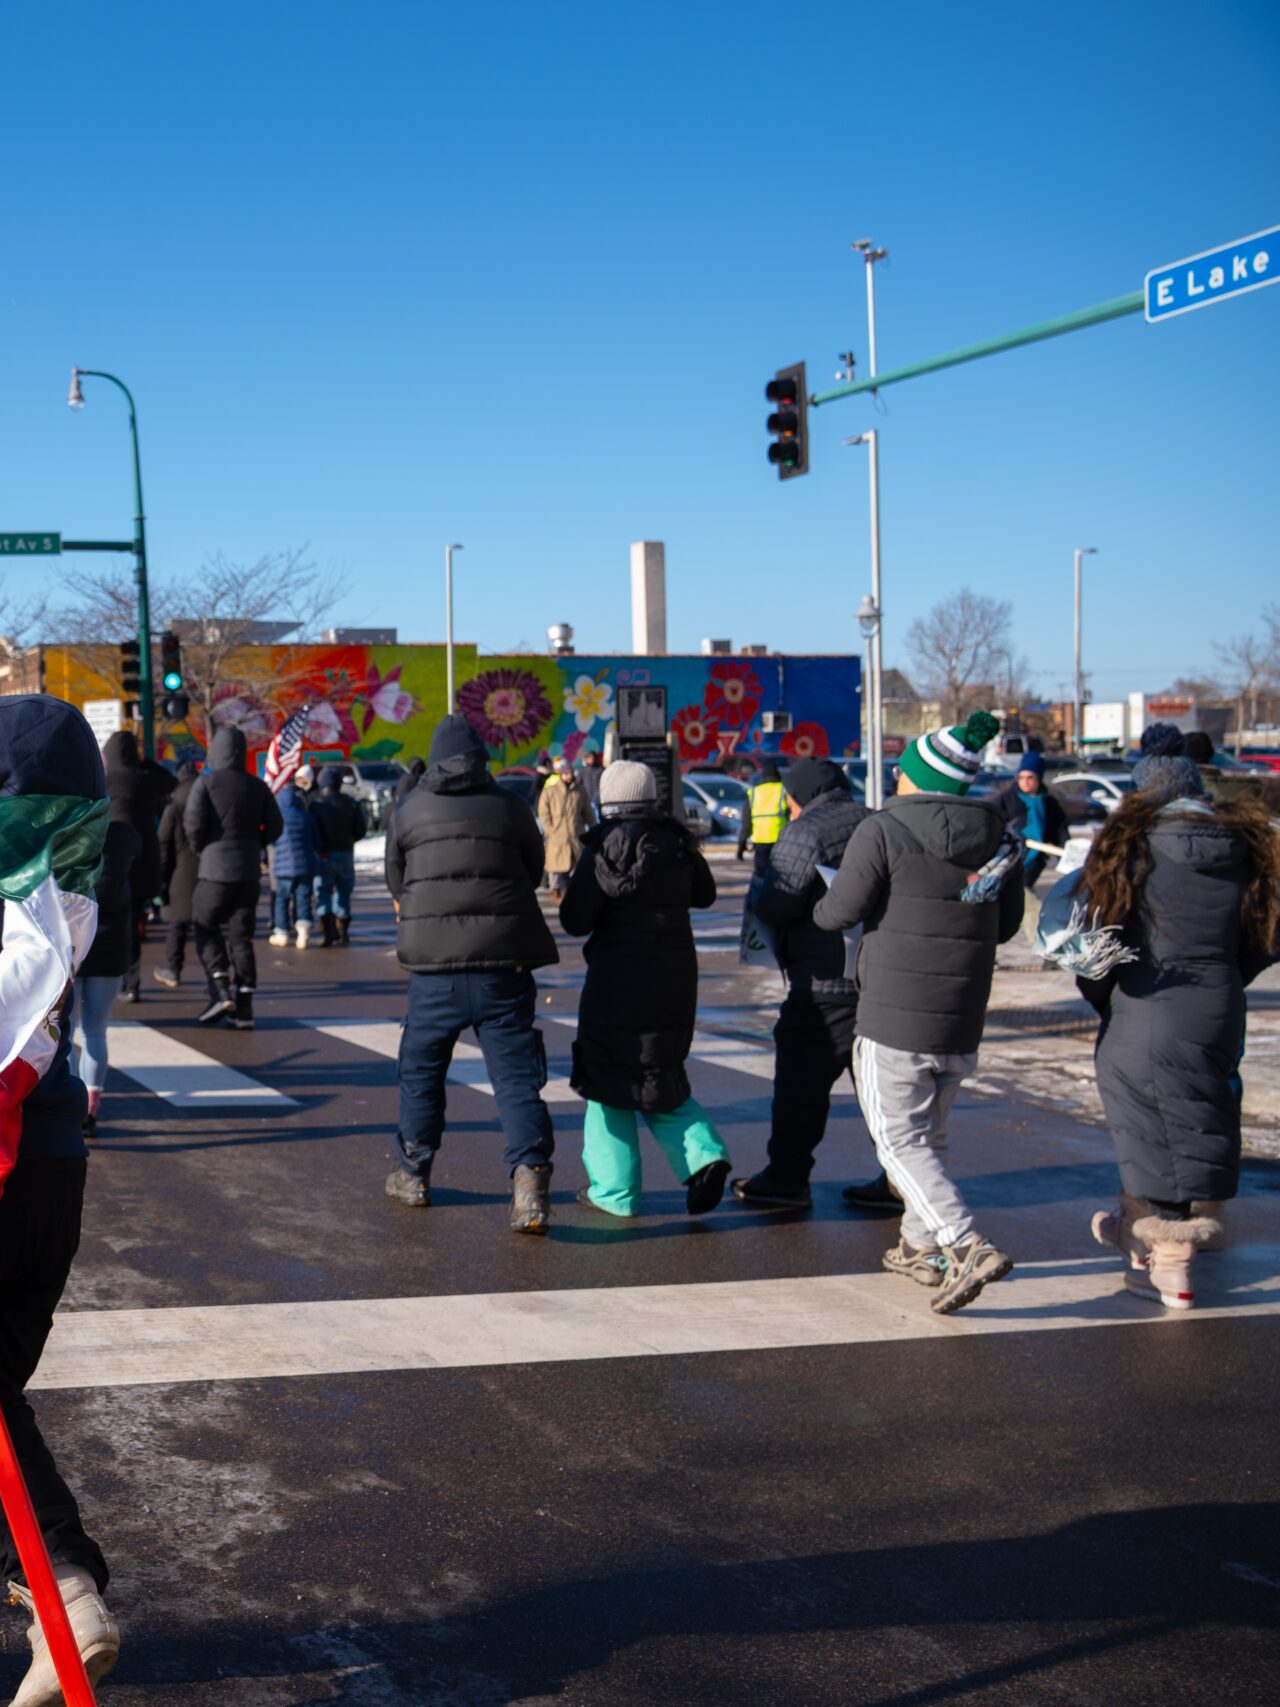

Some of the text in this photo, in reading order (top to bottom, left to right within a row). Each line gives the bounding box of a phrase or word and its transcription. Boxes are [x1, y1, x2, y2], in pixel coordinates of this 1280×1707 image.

[1157, 251, 1269, 307] E Lake
[15, 538, 37, 551] Av
[42, 538, 53, 550] S
